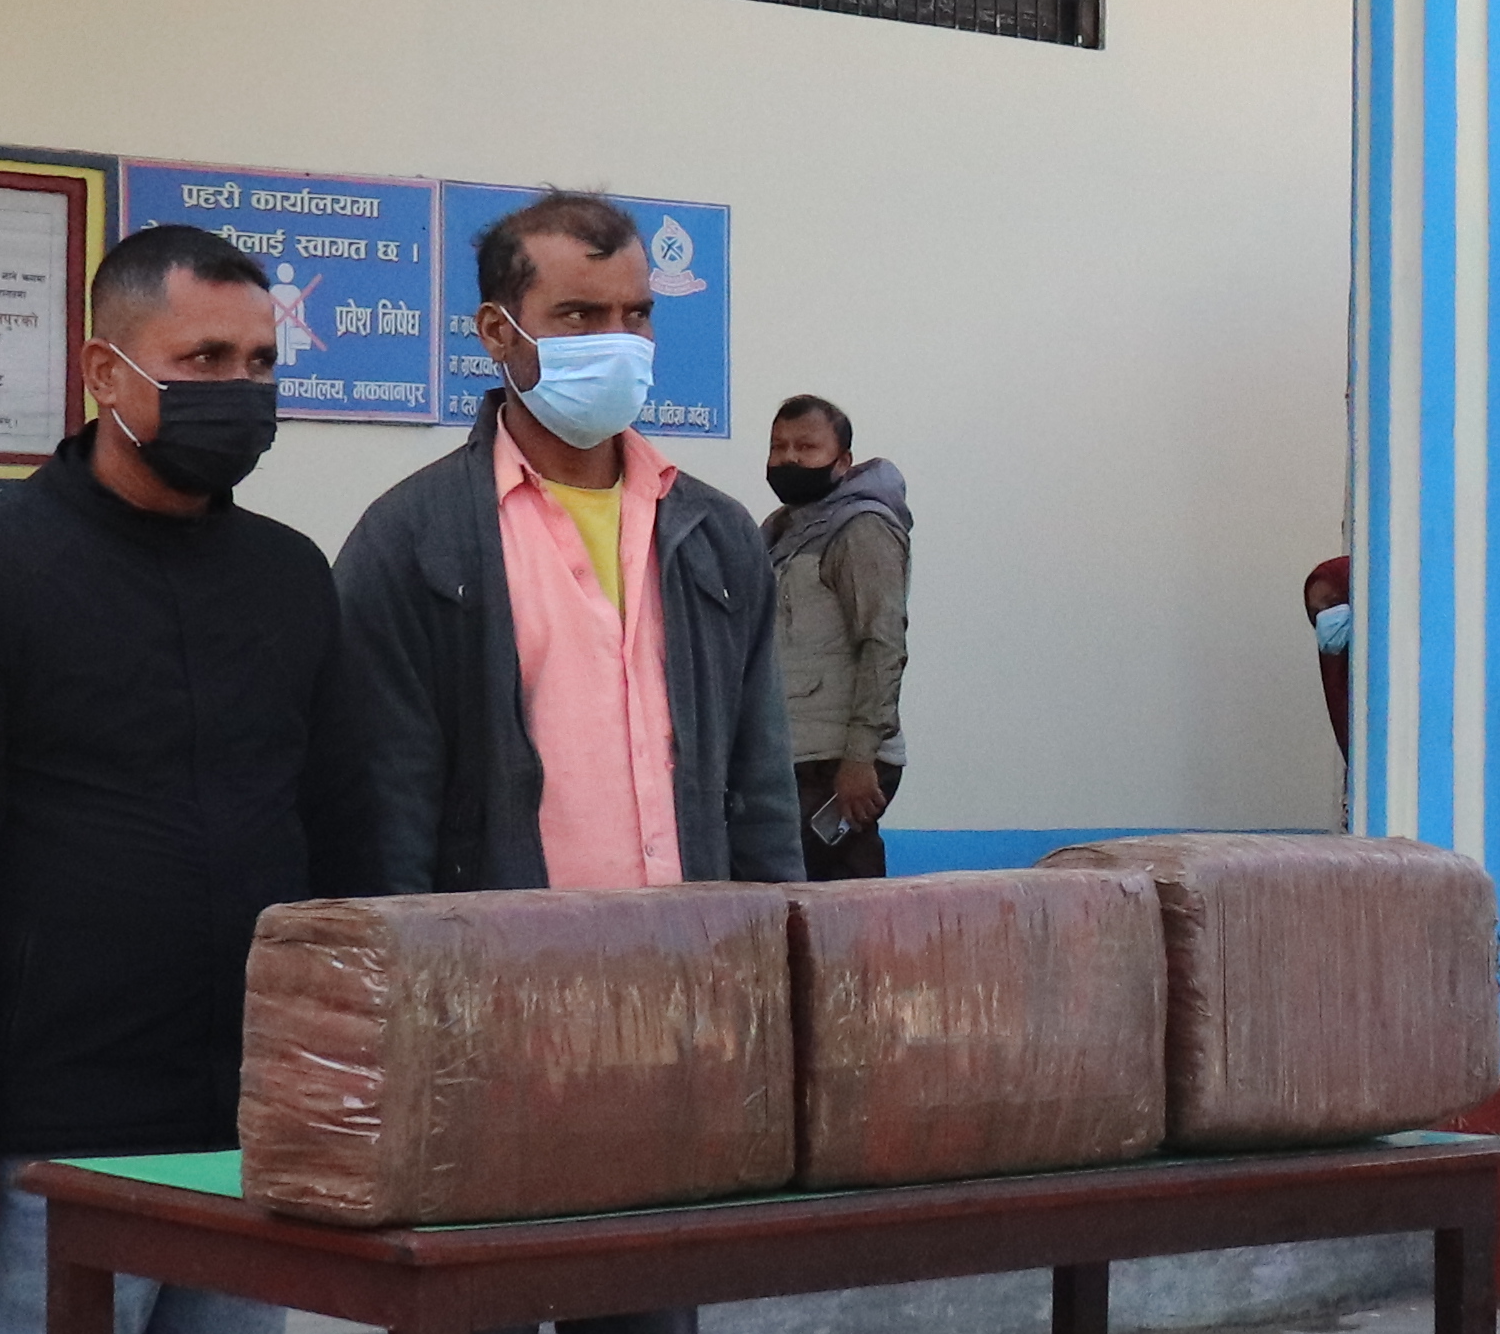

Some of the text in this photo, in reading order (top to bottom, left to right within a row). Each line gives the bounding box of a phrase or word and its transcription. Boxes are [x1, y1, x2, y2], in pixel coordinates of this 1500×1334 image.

[181, 181, 380, 218] प्रहरी कार्यालयमा
[295, 235, 368, 260] स्वागत
[377, 240, 400, 263] छ
[335, 298, 373, 337] प्रवेश
[377, 298, 421, 337] निषेध
[278, 372, 427, 408] कार्यालय, मकवानपुर
